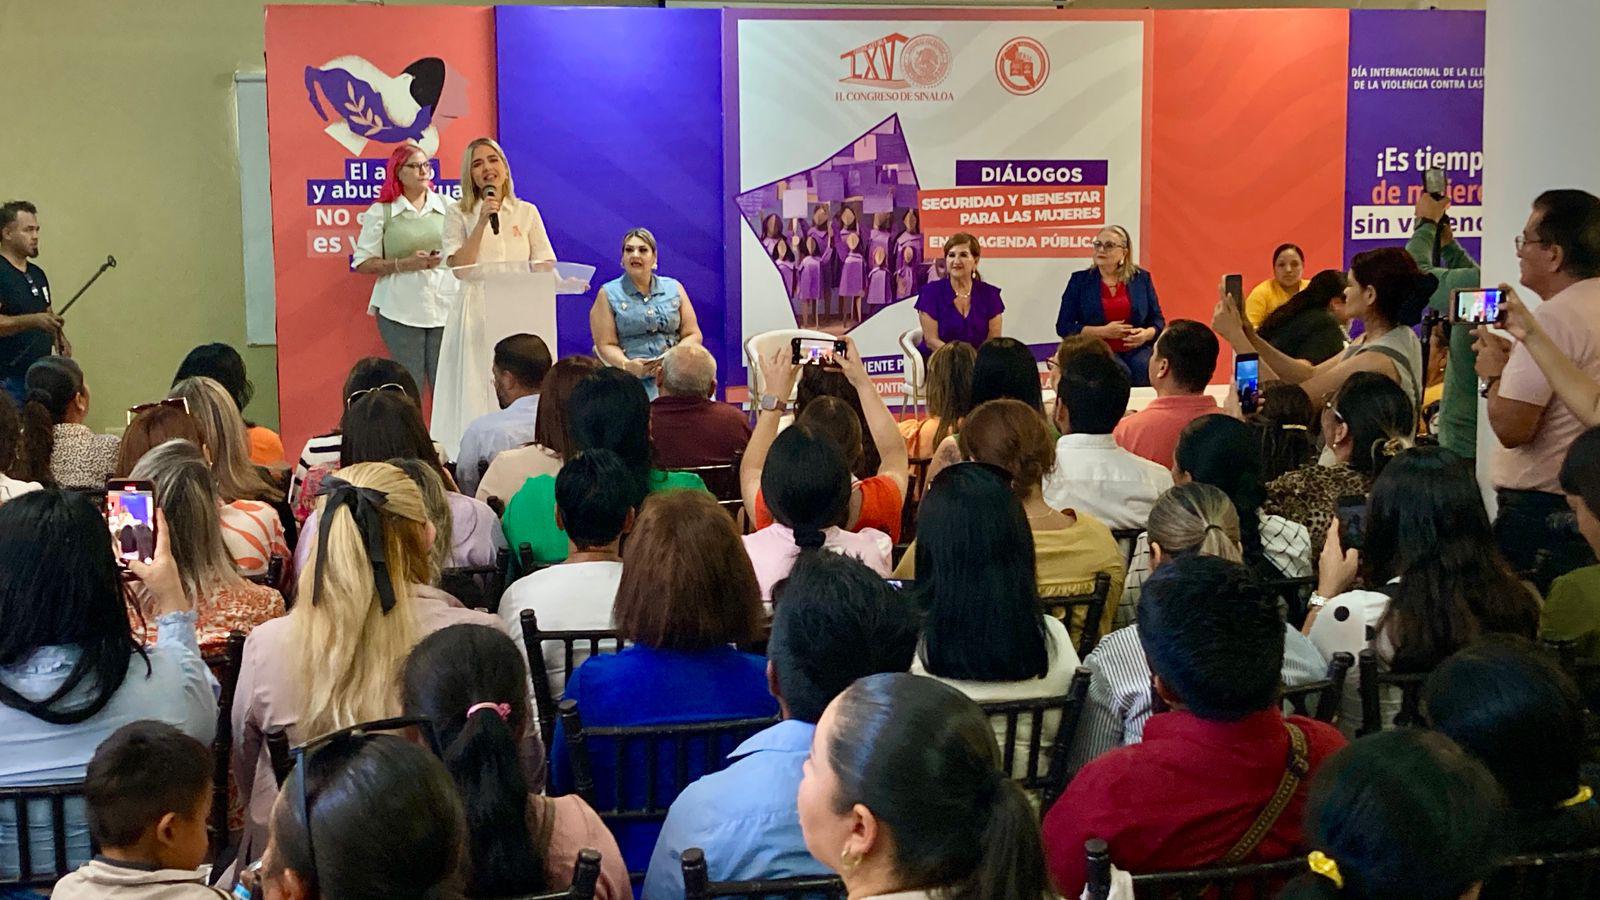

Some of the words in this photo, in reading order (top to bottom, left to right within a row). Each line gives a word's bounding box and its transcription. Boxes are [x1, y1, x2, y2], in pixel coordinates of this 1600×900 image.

[1351, 65, 1367, 77] DÍA
[1370, 67, 1440, 77] INTERNACIONAL
[1443, 67, 1454, 76] DE
[1457, 67, 1467, 76] LA
[1354, 80, 1365, 89] DE
[1368, 80, 1378, 89] LA
[1381, 80, 1428, 89] VIOLENCIA
[1431, 80, 1465, 89] CONTRA
[1468, 80, 1483, 89] LAS
[846, 91, 898, 101] CONGRESO
[900, 92, 912, 101] DE
[914, 91, 954, 101] SINALOA
[1377, 147, 1409, 177] ¡Es
[1415, 146, 1483, 177] tiemp
[350, 162, 367, 180] El
[981, 163, 1083, 183] DIÁLOGOS
[312, 185, 326, 204] y
[331, 181, 383, 199] abus
[921, 195, 1005, 210] SEGURIDAD
[1008, 194, 1019, 207] Y
[1022, 190, 1101, 206] BIENESTAR
[1372, 179, 1400, 205] de
[316, 209, 350, 226] NO
[960, 211, 1001, 225] PARA
[1003, 210, 1032, 223] LAS
[1035, 207, 1102, 221] MUJERES
[1354, 213, 1390, 234] sin
[313, 236, 342, 253] es
[929, 236, 949, 248] EN
[978, 236, 1037, 249] AGENDA
